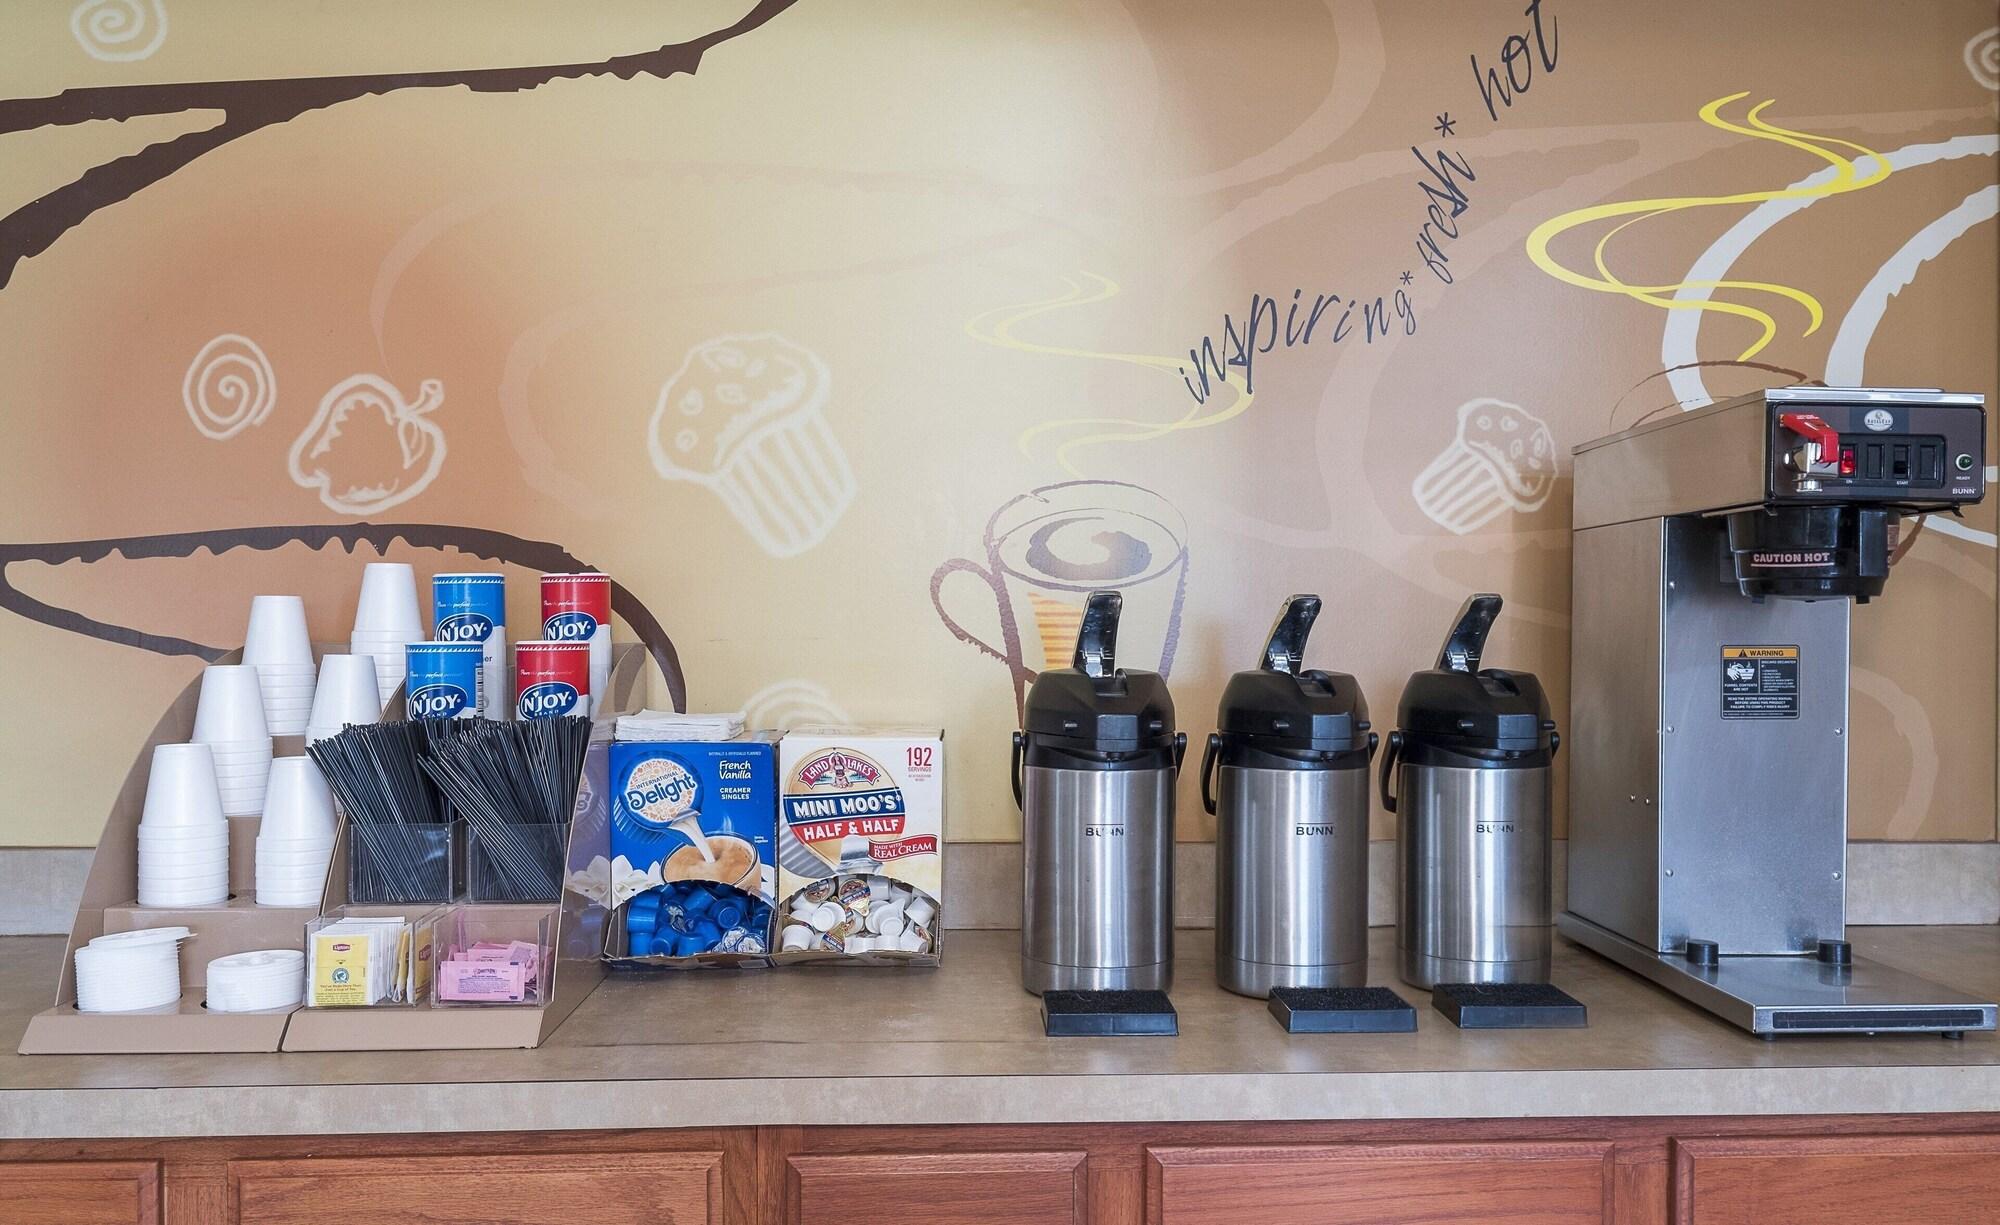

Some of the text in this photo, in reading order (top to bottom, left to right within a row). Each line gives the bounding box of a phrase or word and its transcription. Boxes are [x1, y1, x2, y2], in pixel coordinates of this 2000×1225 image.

[1470, 0, 1558, 121] hot
[1753, 552, 1830, 562] CAUTION HOT
[720, 760, 752, 769] French
[907, 746, 932, 767] 192
[719, 770, 752, 780] Vanilla
[805, 760, 829, 780] LAND
[847, 759, 873, 776] LAKES
[636, 771, 679, 789] INTERNATIONAL
[627, 773, 696, 811] Delight
[793, 794, 897, 818] MINI MOO'S
[803, 819, 899, 841] HALF & HALF
[1086, 827, 1124, 837] BUN
[1296, 826, 1334, 836] BUNN
[874, 842, 932, 859] REAL CREAM
